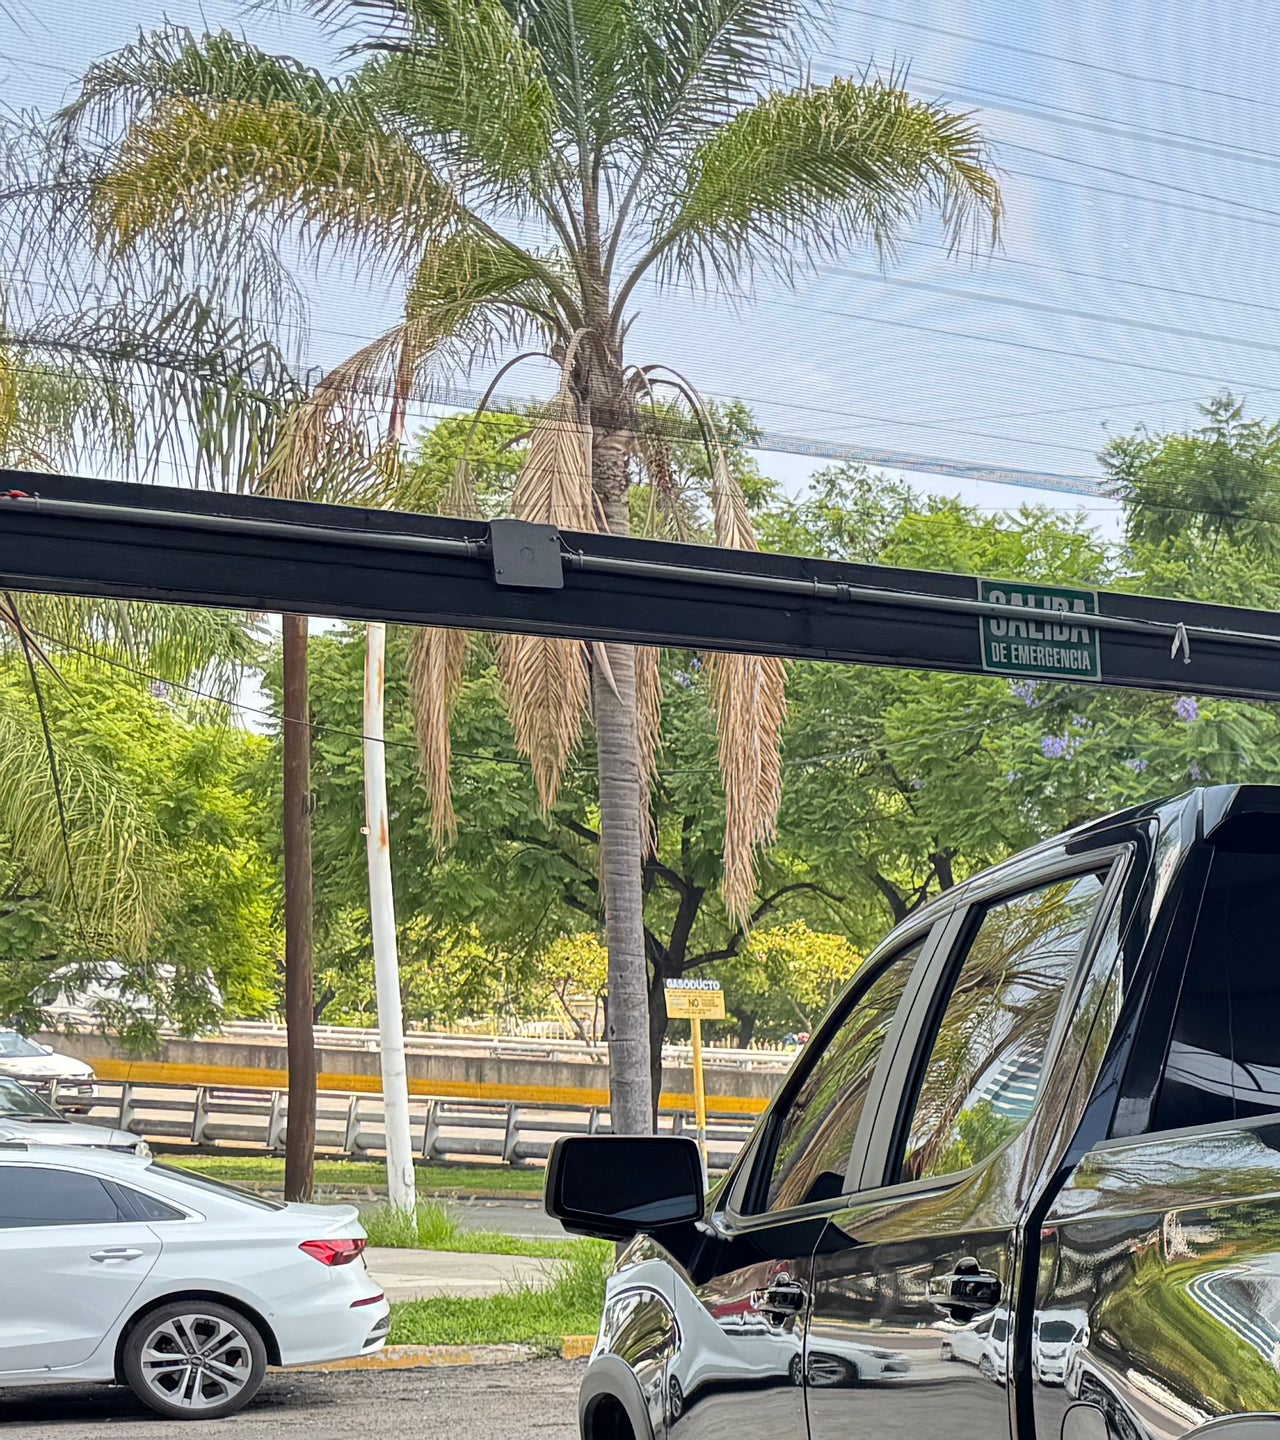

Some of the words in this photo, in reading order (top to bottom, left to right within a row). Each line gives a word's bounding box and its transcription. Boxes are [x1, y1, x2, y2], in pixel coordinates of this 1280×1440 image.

[989, 590, 1090, 643] SALIDA
[991, 642, 1008, 663] DE
[1011, 644, 1091, 670] EMERGENCIA
[666, 978, 720, 990] GASODUCTO
[688, 998, 699, 1008] NO
